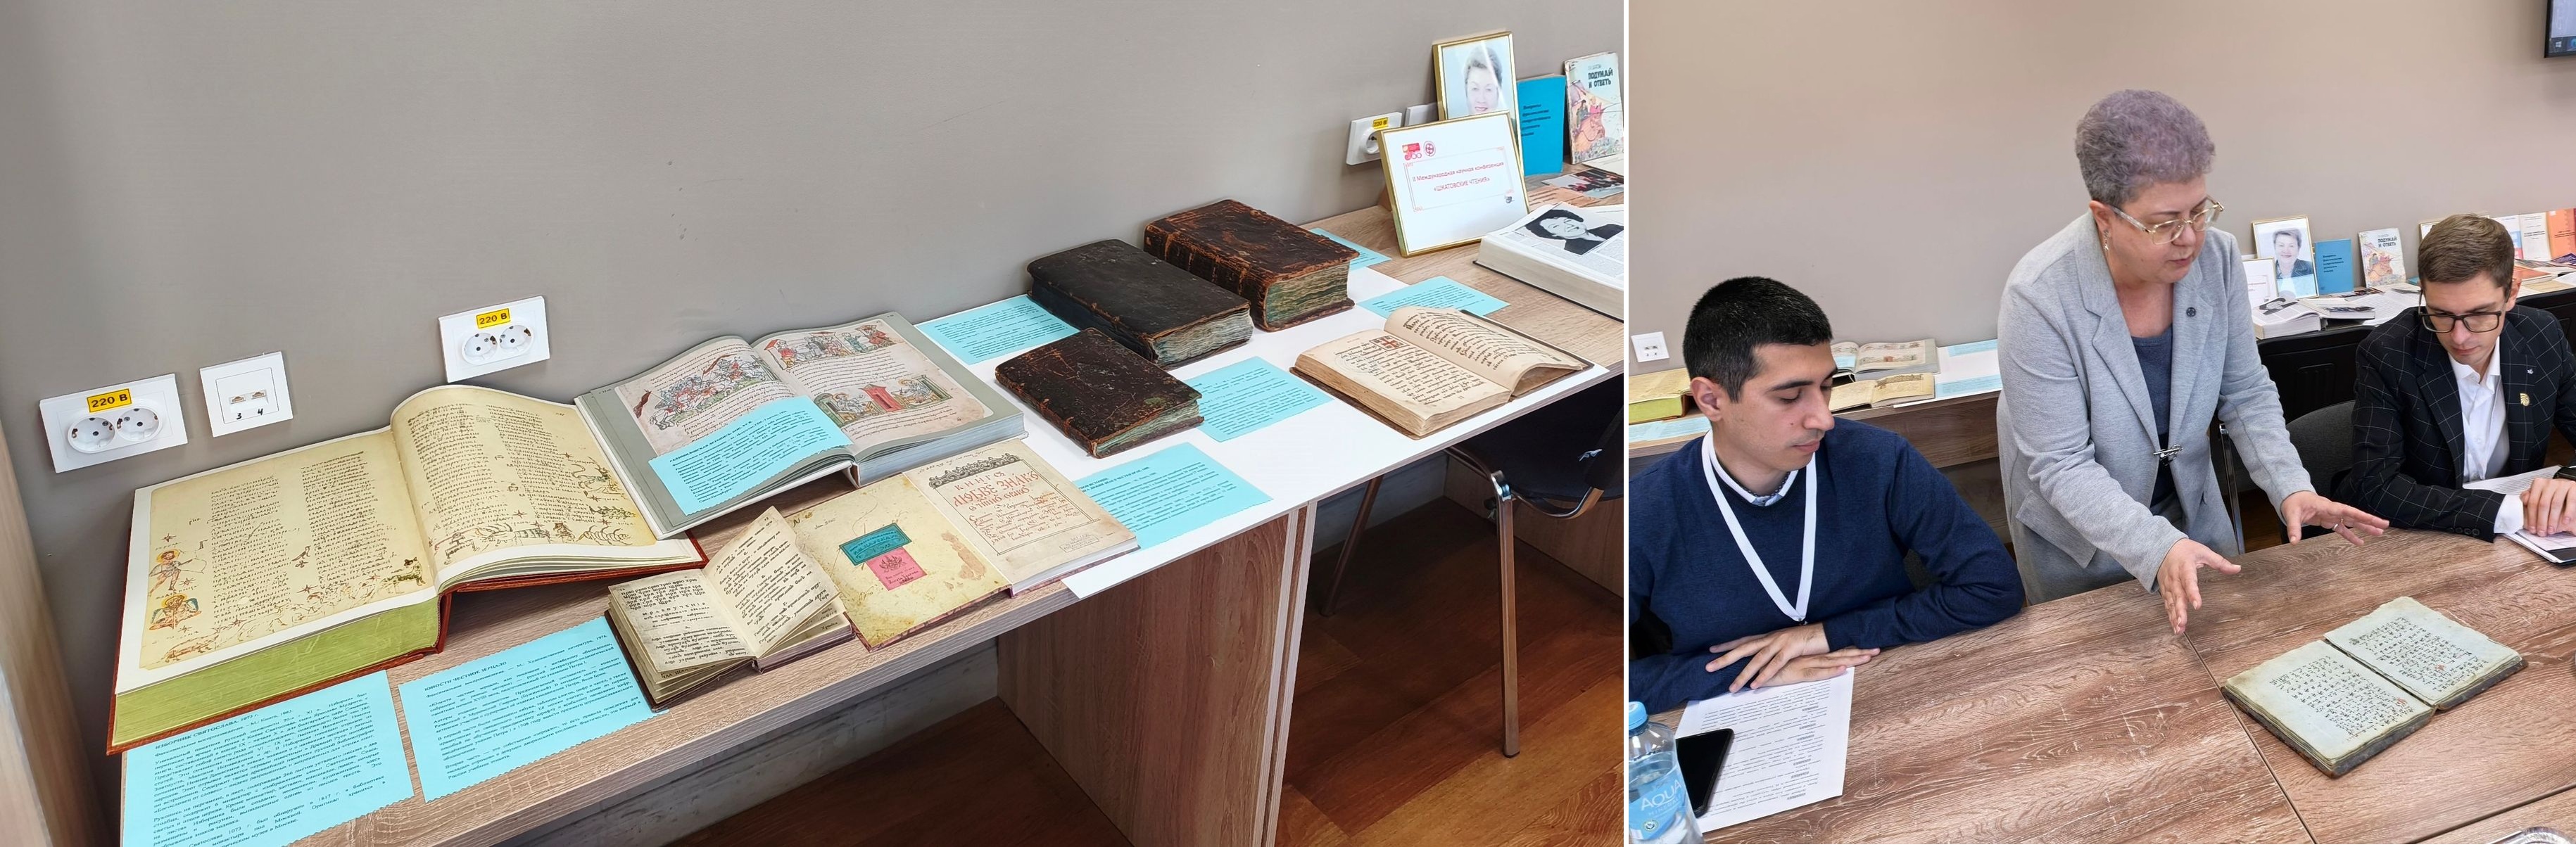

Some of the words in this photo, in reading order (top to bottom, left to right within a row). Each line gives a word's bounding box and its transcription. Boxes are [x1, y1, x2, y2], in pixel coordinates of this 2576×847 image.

[479, 315, 498, 324] 220
[91, 396, 115, 408] 220
[424, 679, 452, 691] ЮНОСТИ
[452, 670, 481, 682] ЧЕСТНОЕ
[155, 734, 191, 749] ИЗБОРНИК
[1641, 779, 1682, 811] AQUA
